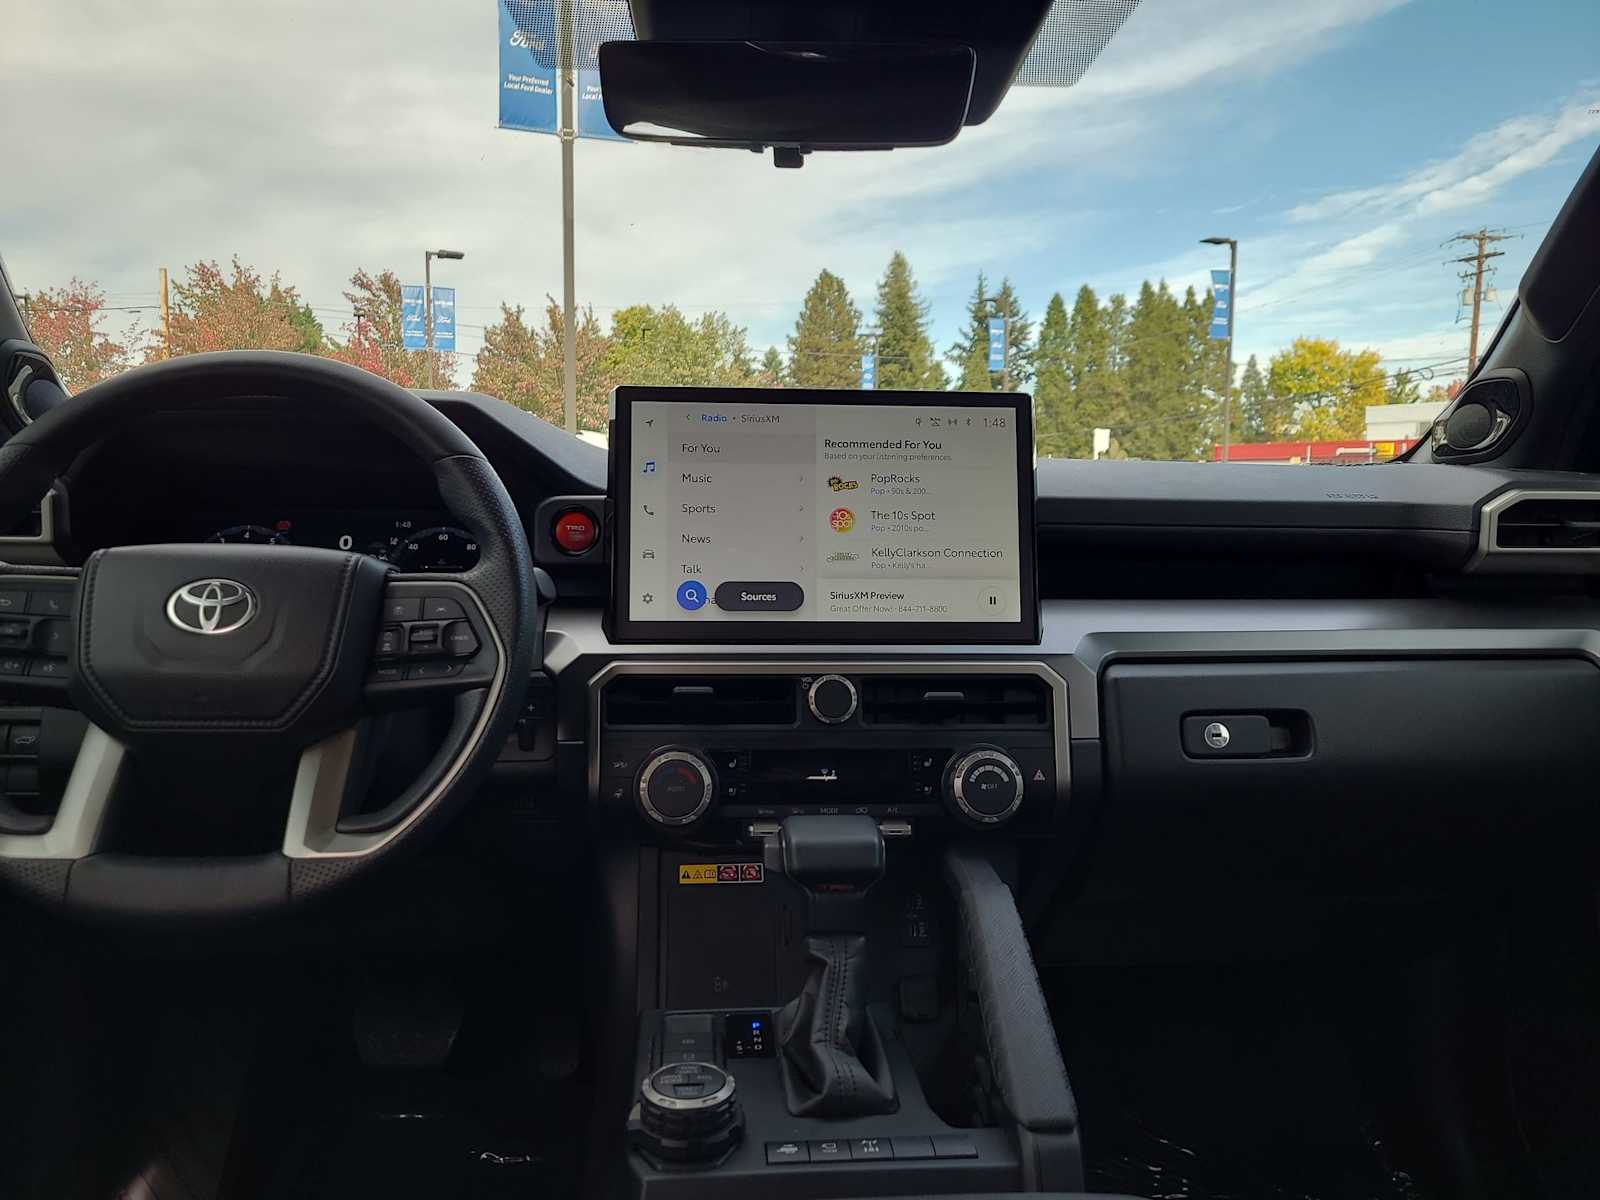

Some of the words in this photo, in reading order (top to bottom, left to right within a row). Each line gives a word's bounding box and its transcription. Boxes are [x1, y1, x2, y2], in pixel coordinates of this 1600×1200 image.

[504, 81, 520, 89] Local
[520, 83, 535, 92] Ford
[701, 414, 728, 422] Radio
[741, 415, 780, 423] SiriusXM
[983, 418, 1006, 428] 1:48
[682, 443, 698, 453] For
[701, 443, 721, 453] You
[824, 439, 902, 449] Recommended
[904, 440, 921, 450] For
[922, 441, 942, 450] You
[824, 452, 847, 460] Based
[859, 454, 875, 463] your
[876, 453, 908, 463] listening
[682, 473, 712, 483] Music
[871, 473, 920, 485] PopRocks
[833, 481, 858, 492] ROCKS
[871, 487, 885, 496] Pop
[891, 487, 904, 495] 90s
[905, 487, 912, 495] &
[682, 504, 717, 516] Sports
[871, 511, 890, 520] The
[893, 511, 909, 520] 10s
[911, 511, 935, 522] Spot
[395, 520, 412, 528] 1:48
[871, 524, 885, 533] Pop
[891, 524, 912, 532] 2010s
[339, 535, 353, 550] 0
[438, 534, 449, 542] 60
[681, 534, 712, 544] News
[408, 543, 419, 551] 40
[466, 543, 477, 551] 80
[871, 548, 941, 559] KellyClarkson
[944, 548, 1003, 558] Connection
[681, 564, 702, 574] Talk
[871, 561, 885, 570] Pop
[892, 561, 915, 570] Kelly's
[740, 591, 777, 602] Sources
[830, 592, 869, 600] SiriusXM
[870, 592, 905, 600] Preview
[830, 605, 850, 613] Great
[852, 605, 872, 613] Offer
